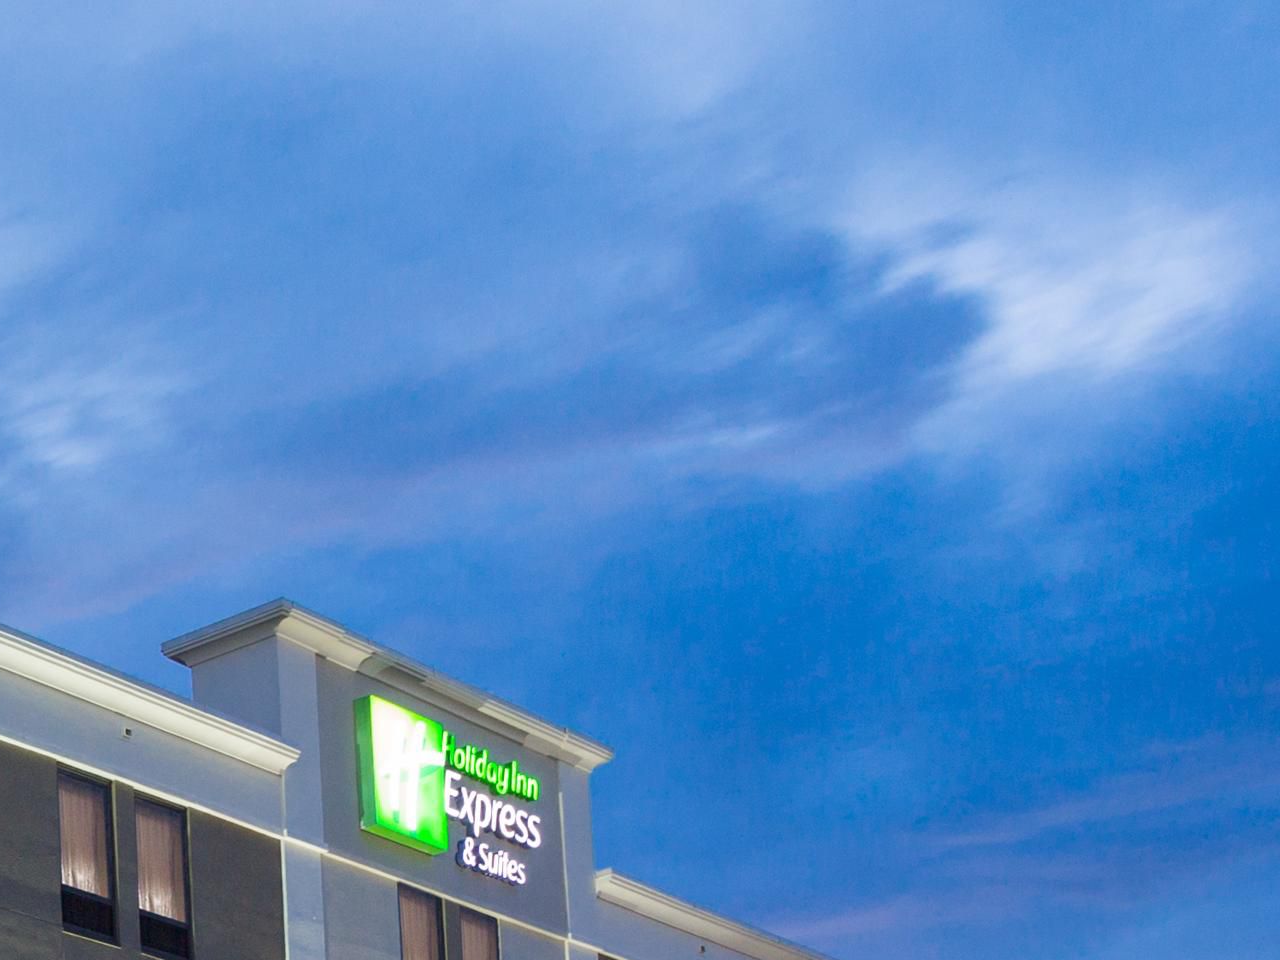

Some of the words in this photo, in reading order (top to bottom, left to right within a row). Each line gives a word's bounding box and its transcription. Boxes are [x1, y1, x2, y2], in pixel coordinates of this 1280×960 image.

[442, 730, 510, 795] Holiday
[511, 760, 539, 801] Inn
[444, 769, 542, 849] Express
[462, 836, 477, 867] &
[478, 843, 527, 885] Suites
